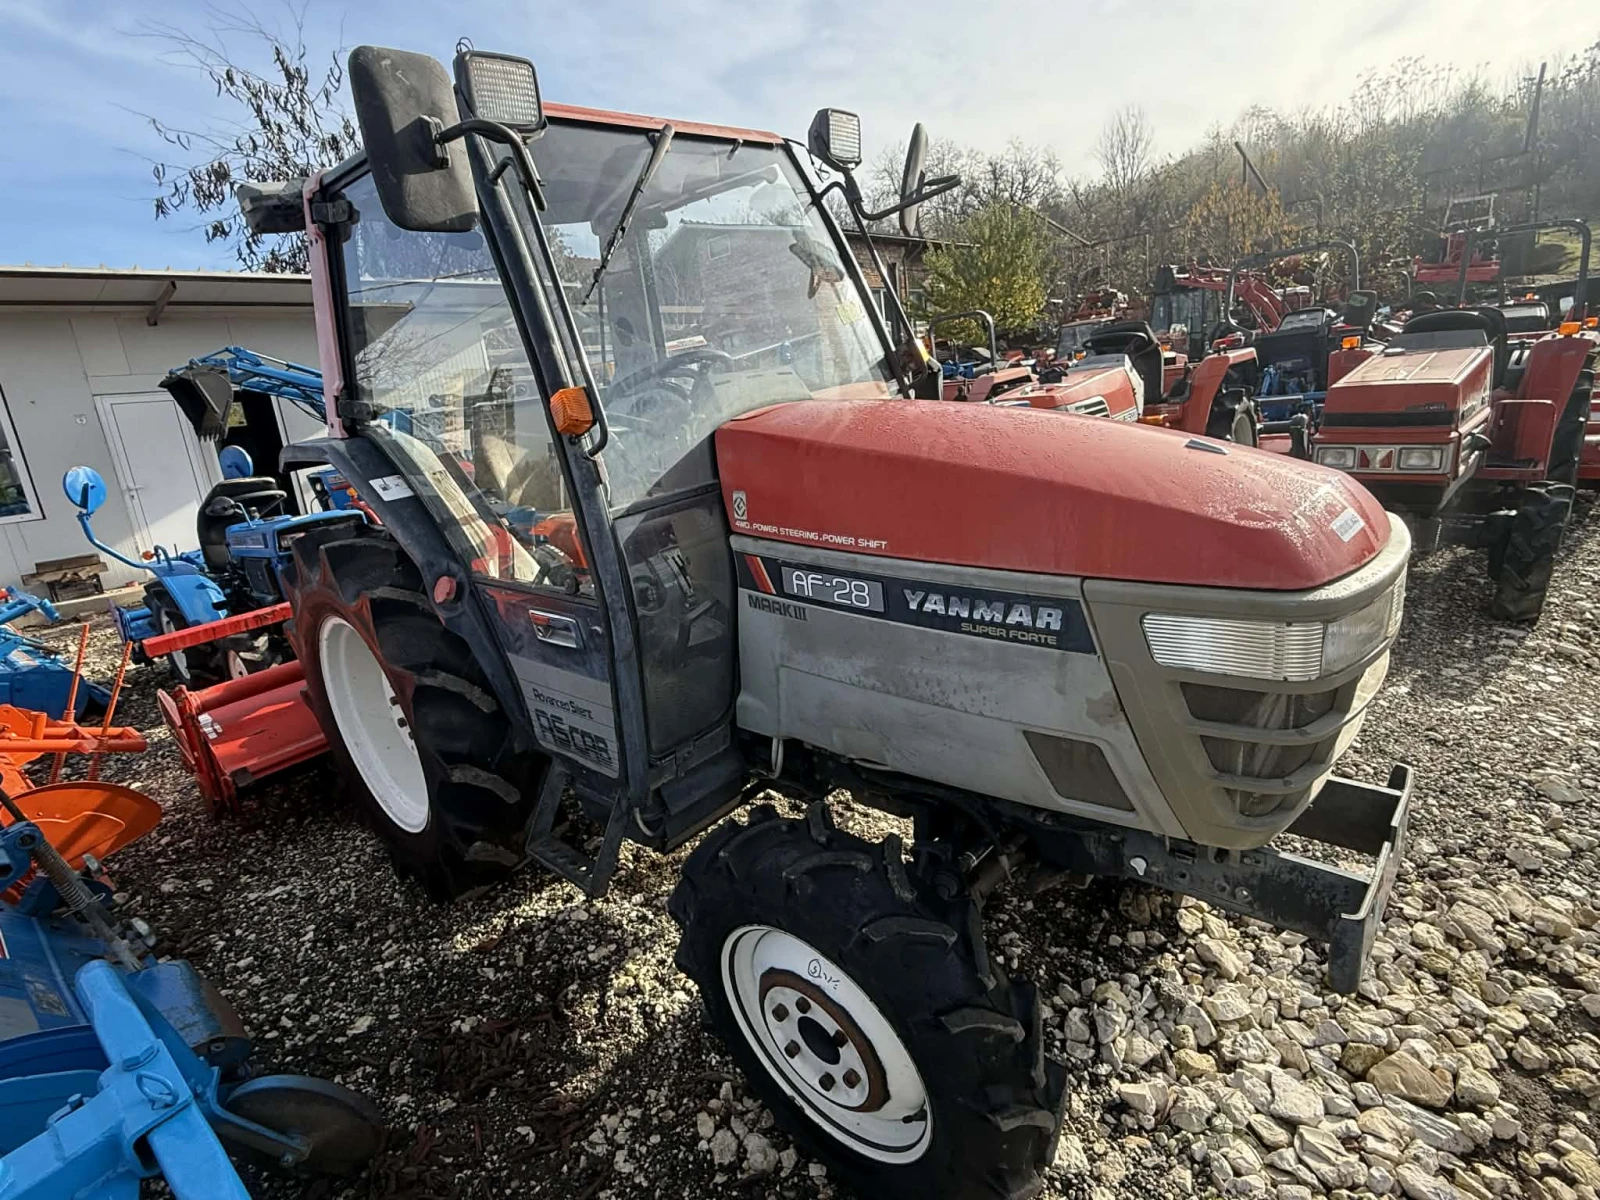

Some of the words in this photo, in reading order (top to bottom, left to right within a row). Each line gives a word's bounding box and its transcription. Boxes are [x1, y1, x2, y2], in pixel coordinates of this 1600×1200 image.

[858, 538, 888, 550] SHIFT
[903, 589, 1063, 631] YANMAR
[961, 622, 1007, 639] SUPER
[1009, 630, 1057, 645] FORTE
